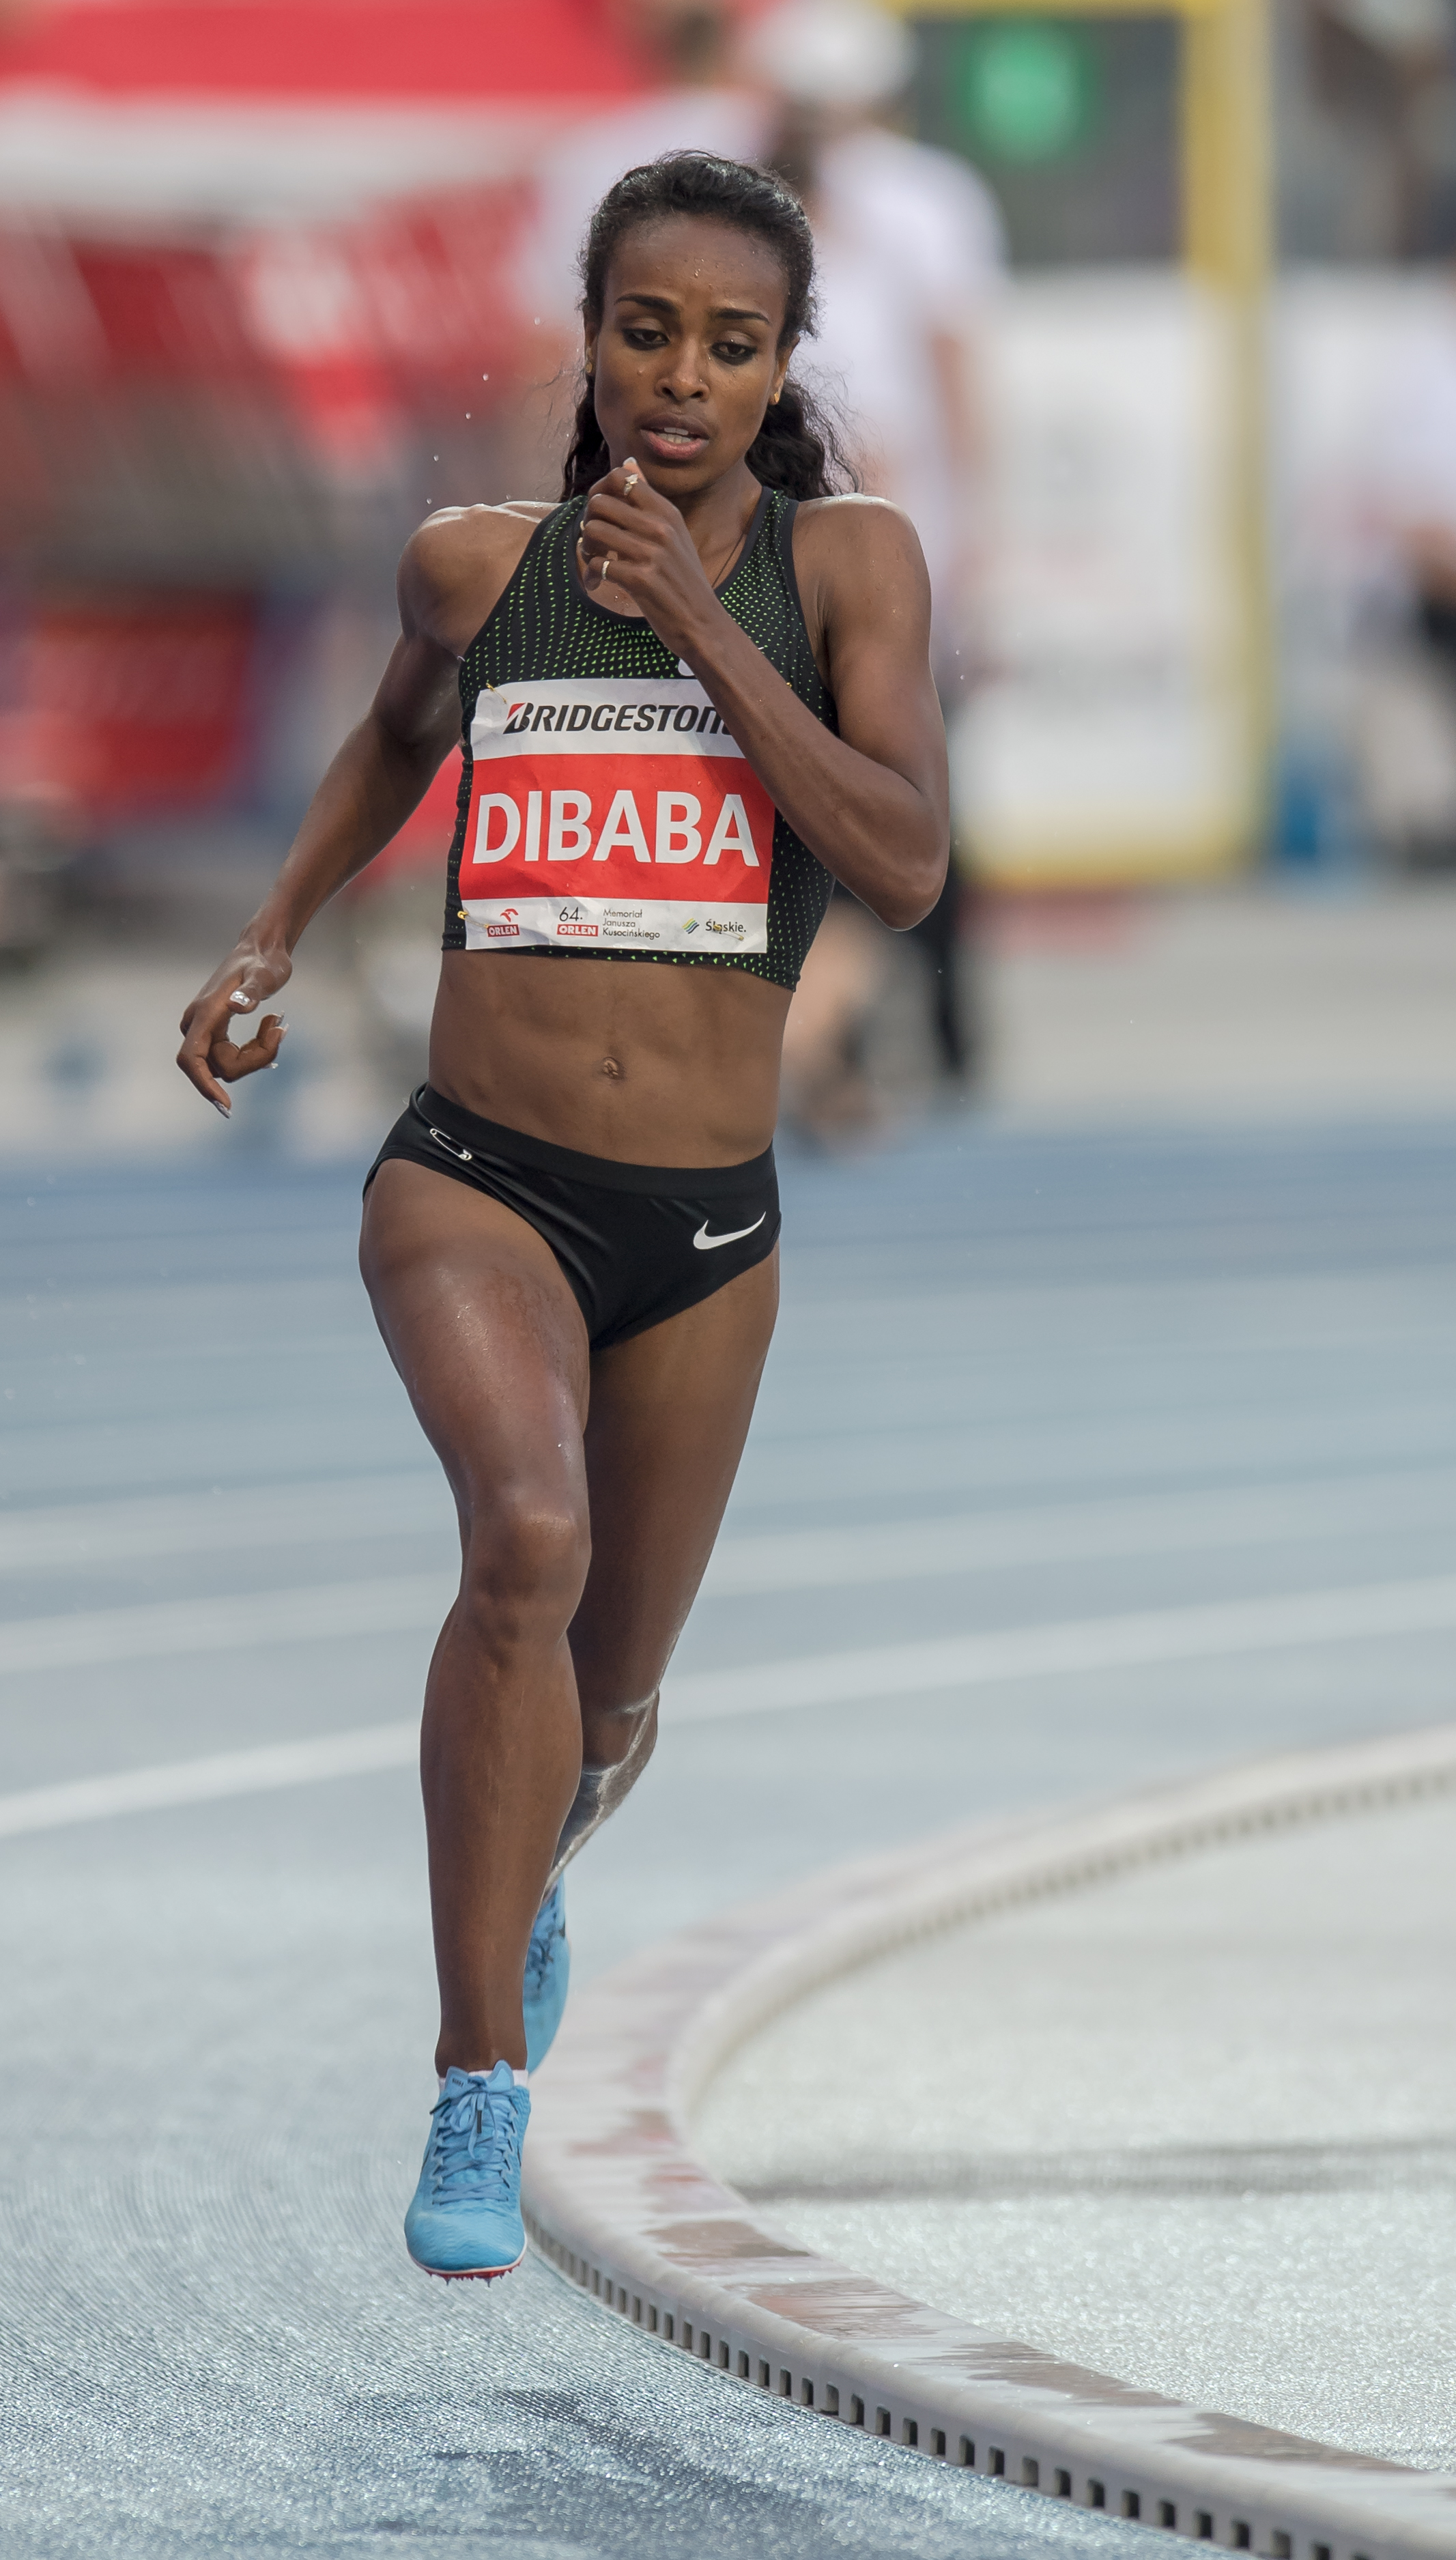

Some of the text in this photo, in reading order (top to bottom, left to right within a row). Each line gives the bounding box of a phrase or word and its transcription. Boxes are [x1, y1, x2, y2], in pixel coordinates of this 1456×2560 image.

[502, 702, 732, 735] BRIDGESTON
[472, 789, 760, 867] DIBABA
[559, 907, 583, 922] 64.
[603, 909, 643, 918] Memoriał
[489, 924, 517, 936] ORLEN
[558, 924, 597, 935] ORLEN
[602, 920, 636, 928] Janusza
[602, 928, 660, 940] Kusocińskiego
